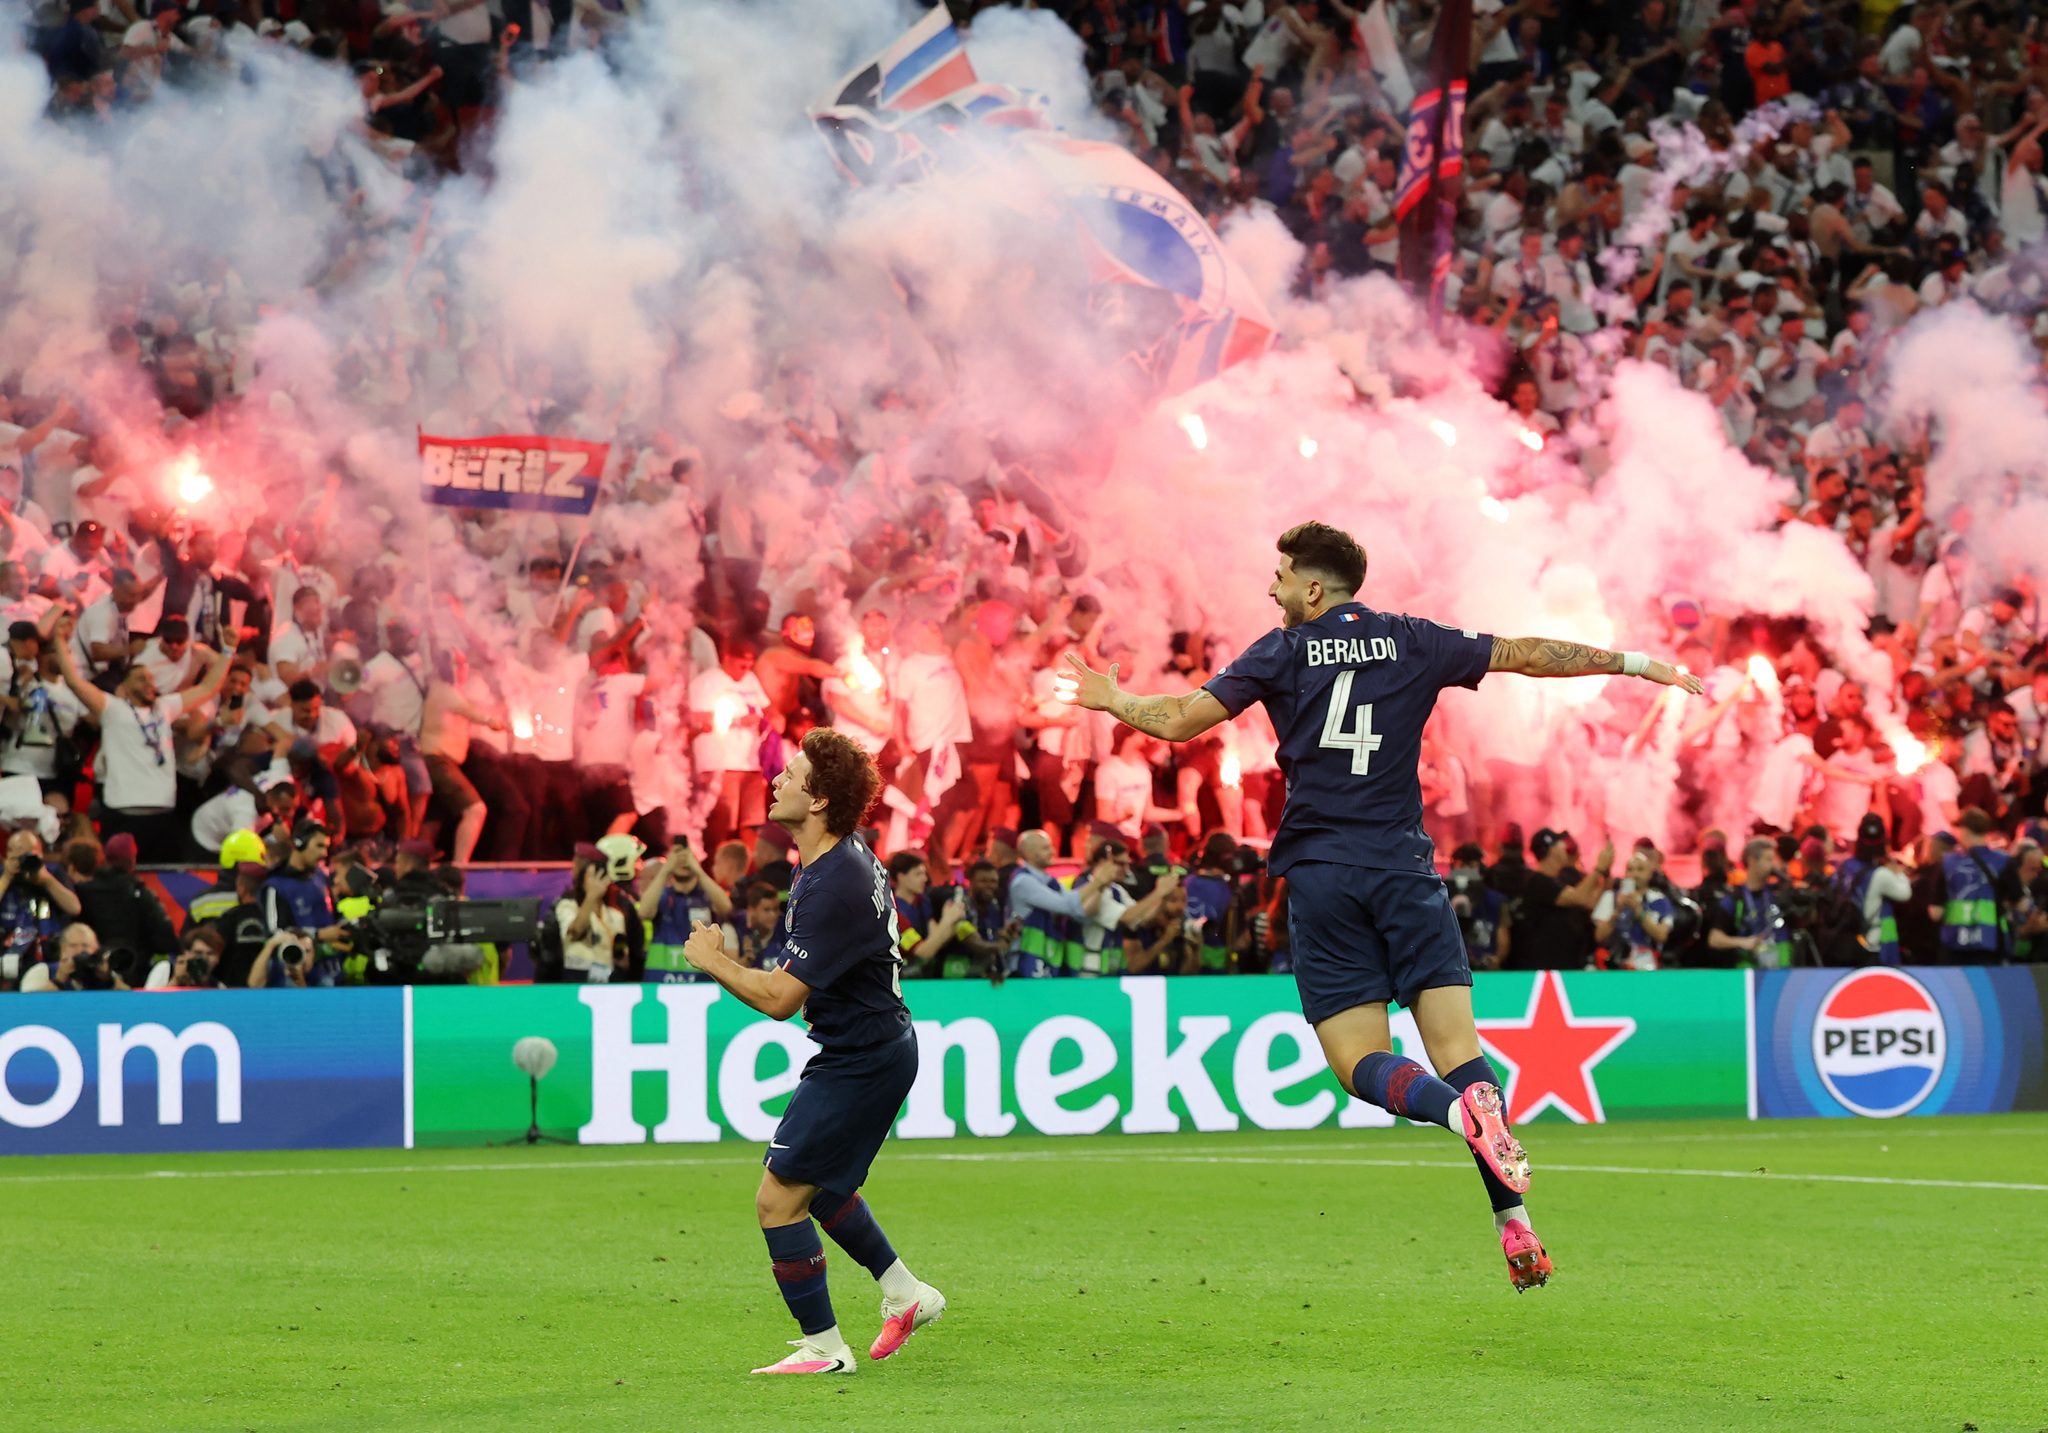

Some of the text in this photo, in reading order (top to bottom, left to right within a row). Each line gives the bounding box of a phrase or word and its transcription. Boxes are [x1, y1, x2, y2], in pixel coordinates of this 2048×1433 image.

[1081, 183, 1214, 256] ERMAIN
[1306, 636, 1398, 667] BERALDO
[1318, 669, 1384, 776] 4
[786, 940, 809, 960] OND
[578, 975, 1443, 1144] Heneke
[1824, 1028, 1935, 1057] PEPSI
